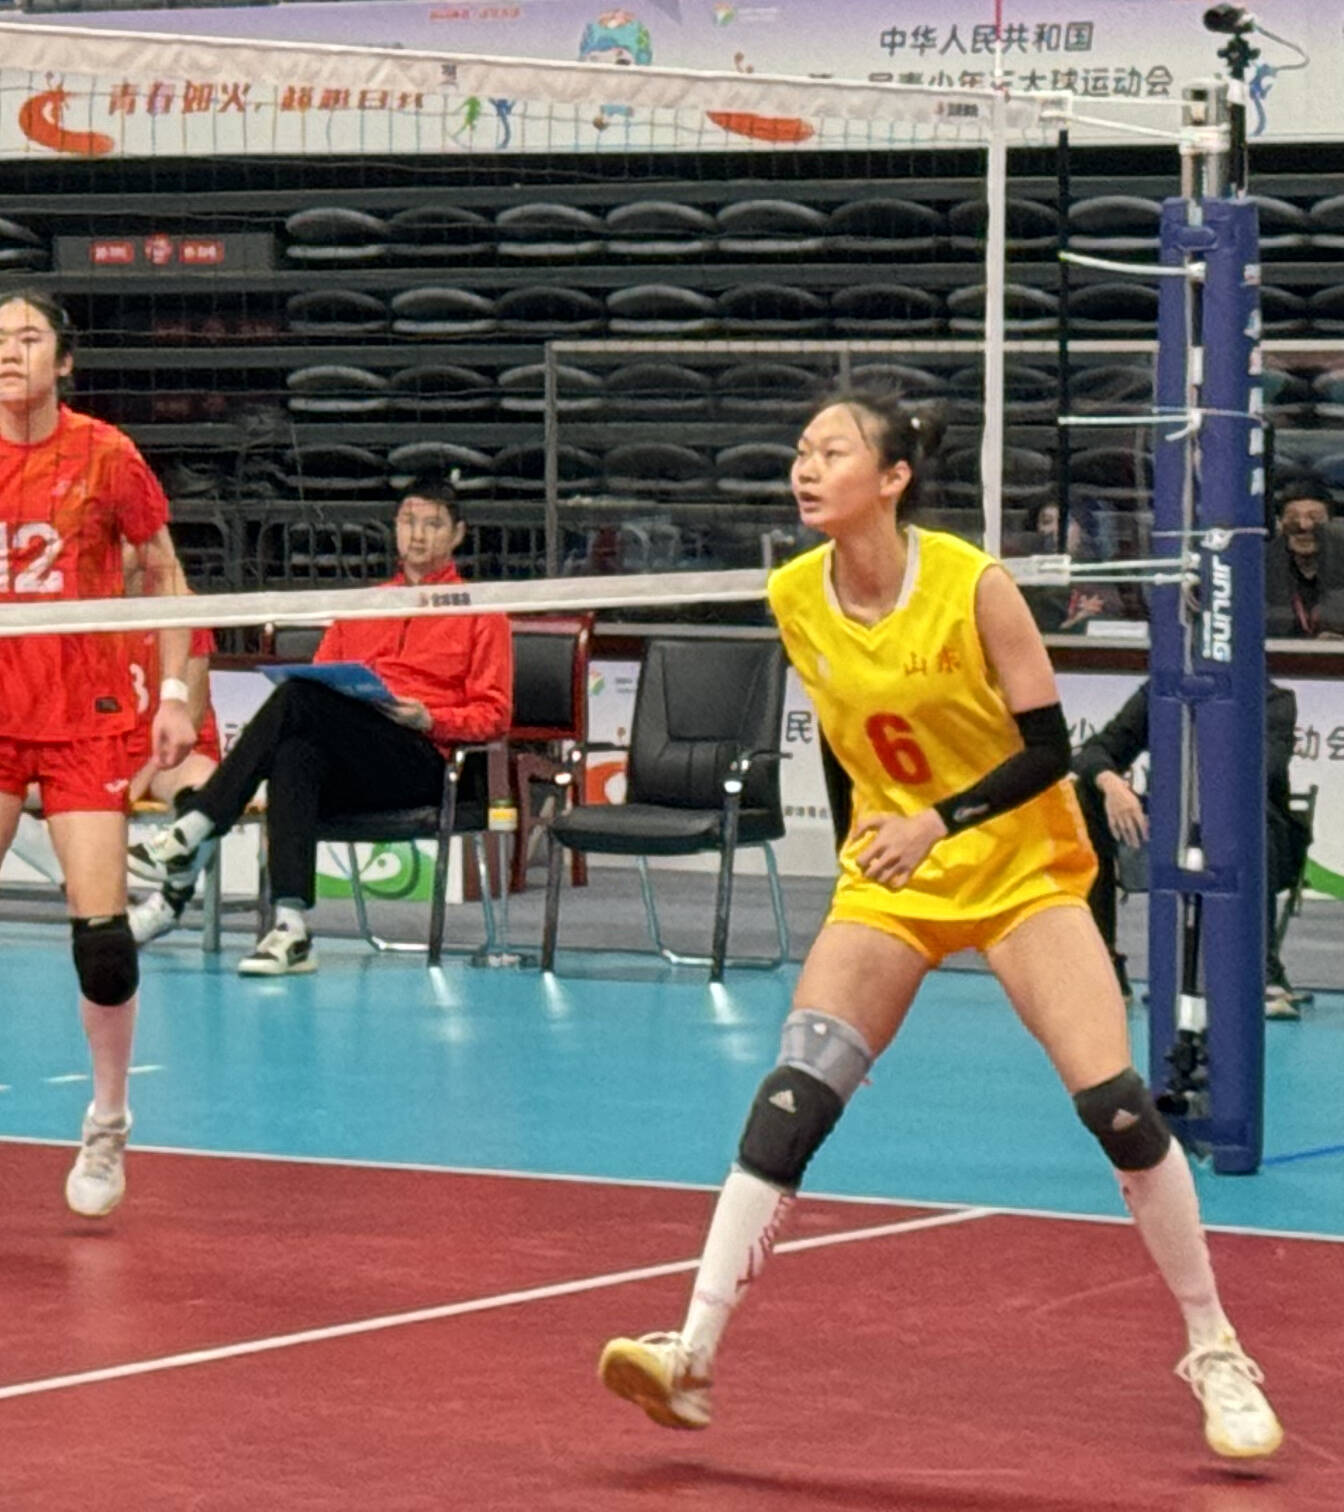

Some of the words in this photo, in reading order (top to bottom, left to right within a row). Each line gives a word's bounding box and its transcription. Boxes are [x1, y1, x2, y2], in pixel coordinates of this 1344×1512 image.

[880, 21, 1094, 56] 中华人民共和国
[1212, 554, 1232, 663] JINLING
[865, 713, 933, 785] 6
